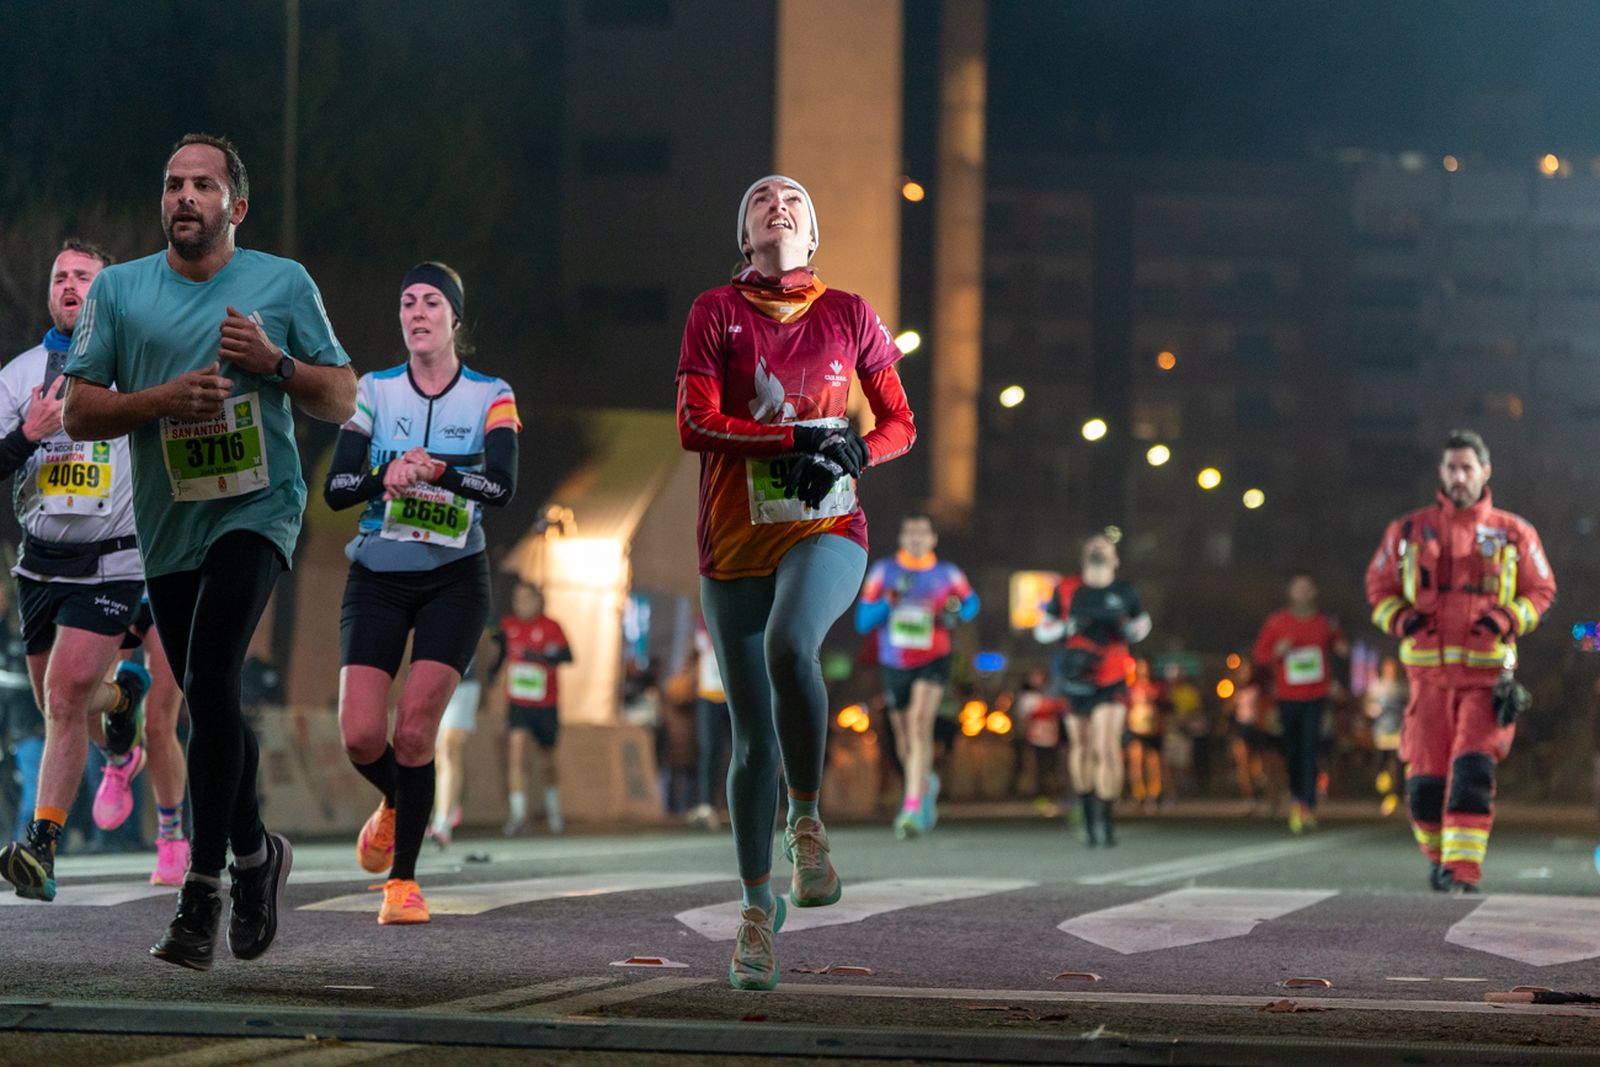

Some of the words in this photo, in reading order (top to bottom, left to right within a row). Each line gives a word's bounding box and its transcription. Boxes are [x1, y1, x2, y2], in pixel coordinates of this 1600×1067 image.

[172, 426, 191, 439] SAN
[185, 432, 245, 468] 3716
[48, 463, 100, 488] 4069
[402, 497, 459, 529] 8656
